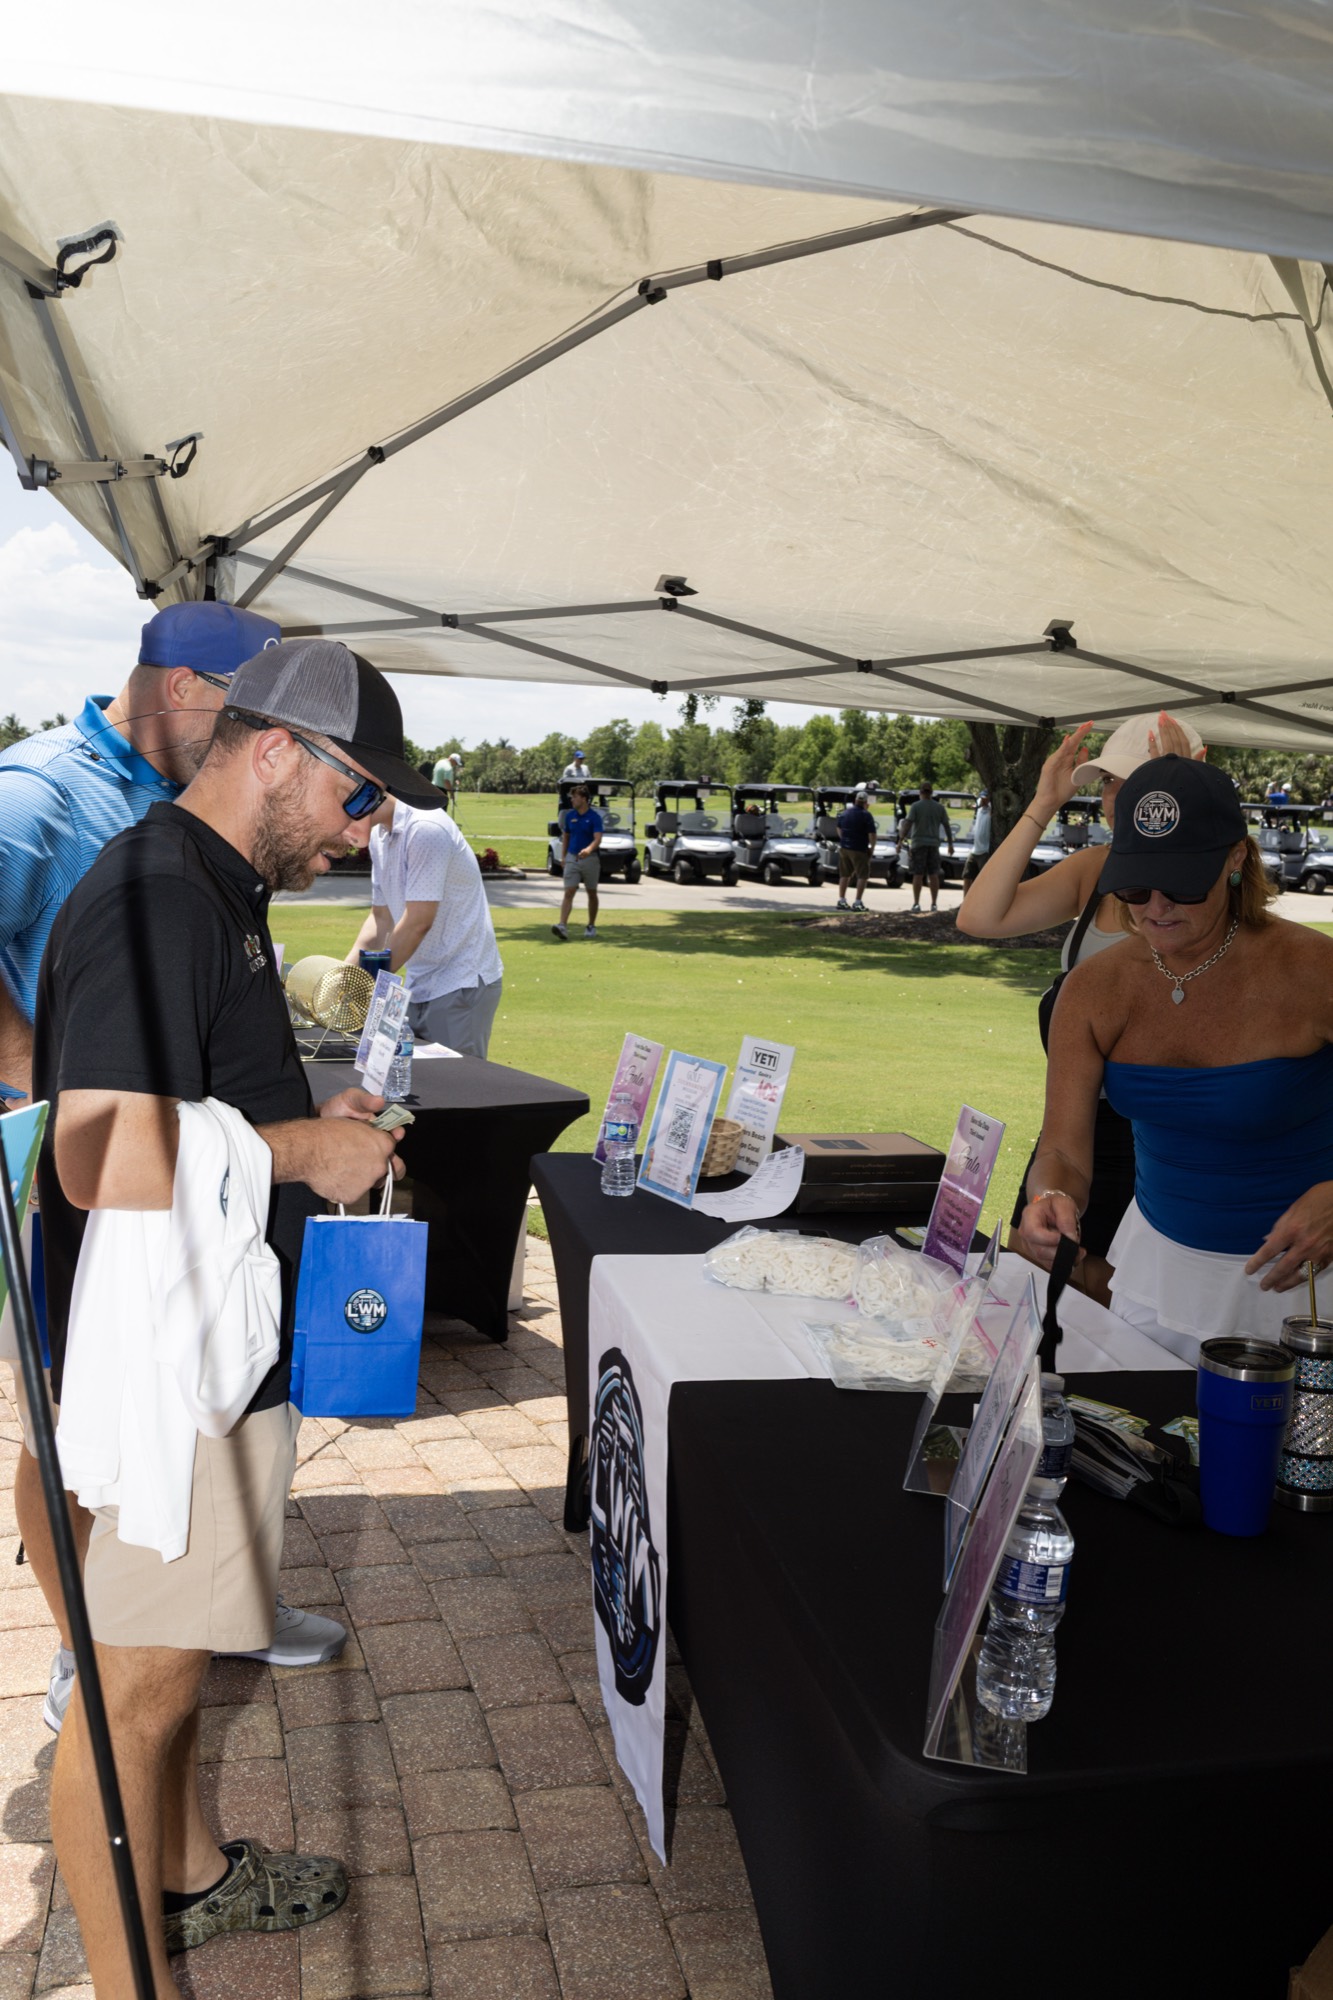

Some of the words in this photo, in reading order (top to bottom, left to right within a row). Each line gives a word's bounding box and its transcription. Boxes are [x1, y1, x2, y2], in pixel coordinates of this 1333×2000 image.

[1137, 807, 1175, 821] LWM
[754, 1051, 777, 1067] YETI
[958, 1145, 980, 1175] Gala
[347, 1303, 385, 1317] LWM
[1254, 1397, 1282, 1407] YETI
